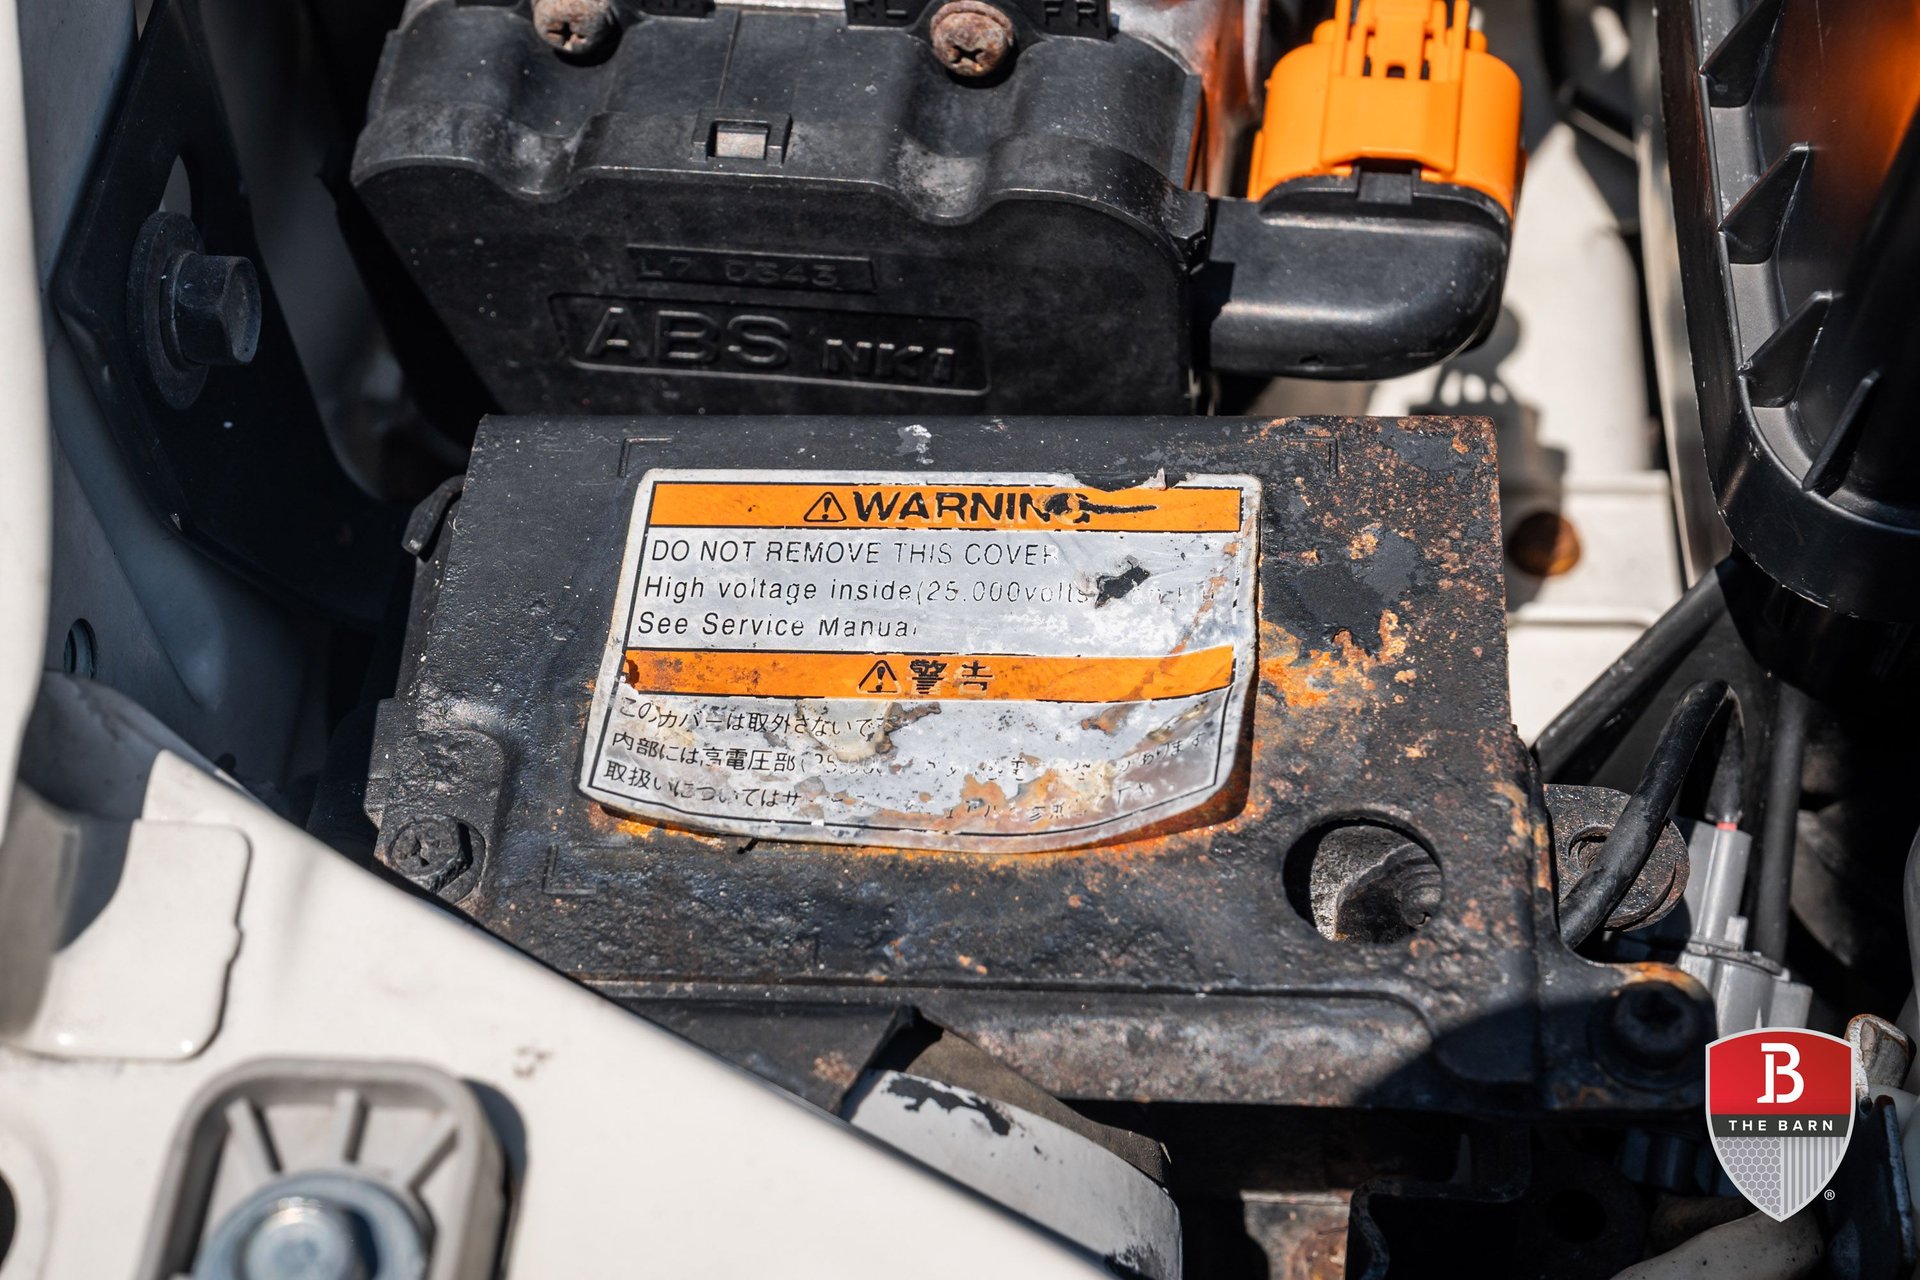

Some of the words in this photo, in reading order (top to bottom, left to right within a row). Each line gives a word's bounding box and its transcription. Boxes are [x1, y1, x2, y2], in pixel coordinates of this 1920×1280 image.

[585, 305, 792, 364] ABS
[821, 337, 956, 381] NK1
[651, 539, 690, 562] DO
[700, 540, 756, 563] NOT
[766, 541, 881, 564] REMOVE
[893, 542, 952, 565] THIS
[644, 576, 704, 604] High
[718, 578, 817, 605] voltage
[638, 611, 688, 635] See
[702, 612, 804, 637] Service
[909, 659, 994, 695] 警告
